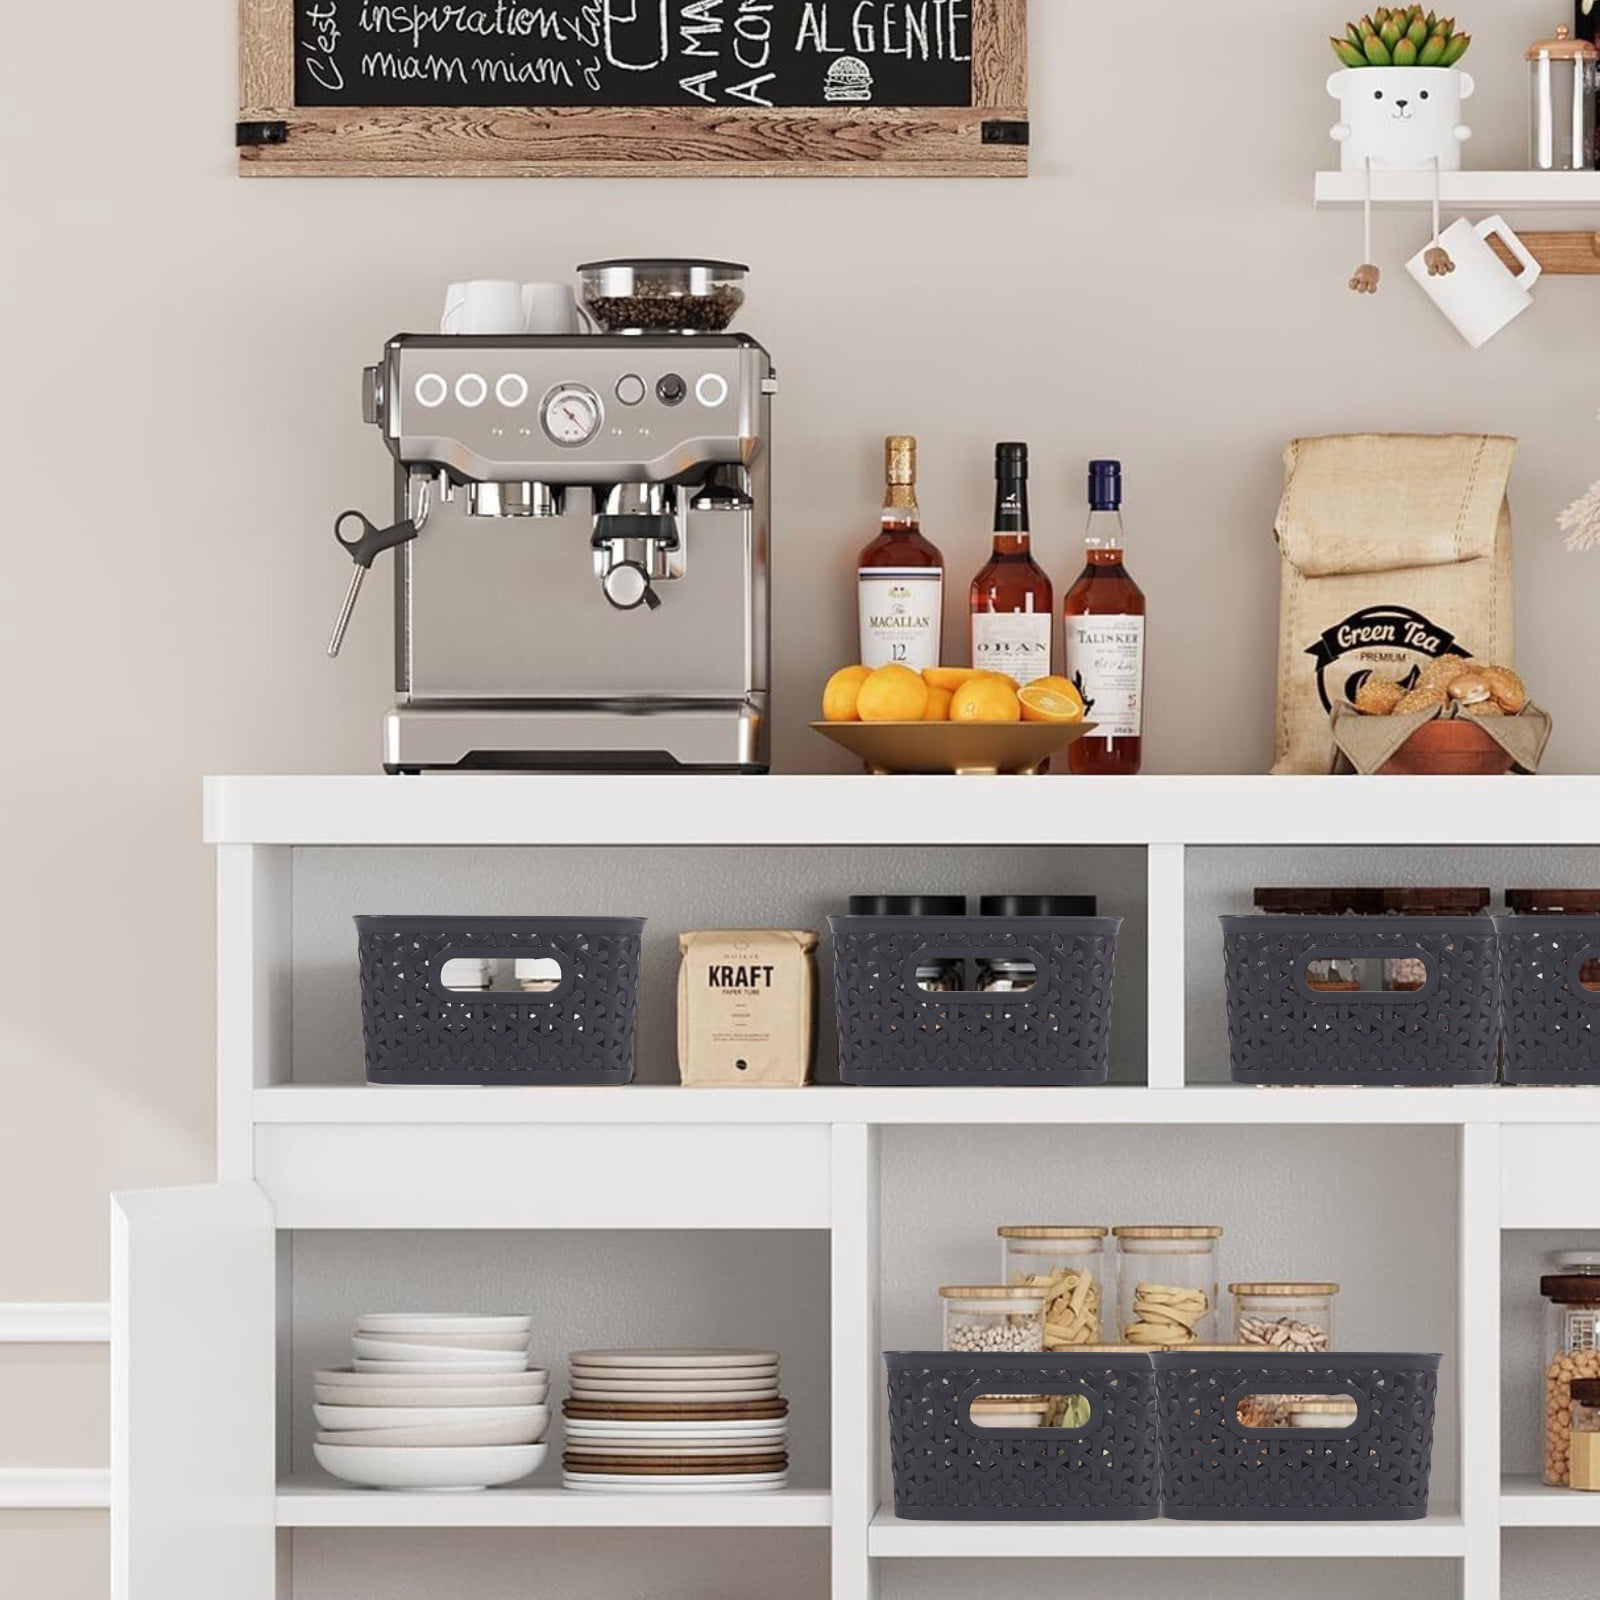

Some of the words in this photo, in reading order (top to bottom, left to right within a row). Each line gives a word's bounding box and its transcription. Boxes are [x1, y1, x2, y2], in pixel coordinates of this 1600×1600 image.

[359, 0, 568, 48] inspiration
[794, 2, 845, 53] AL
[678, 69, 718, 103] A
[724, 72, 777, 107] A
[869, 615, 930, 629] MACALLAN
[1337, 623, 1396, 648] Green
[1403, 620, 1442, 653] Tea
[892, 643, 907, 661] 12
[1360, 651, 1407, 663] PREMIUM
[708, 965, 775, 988] KRAFT
